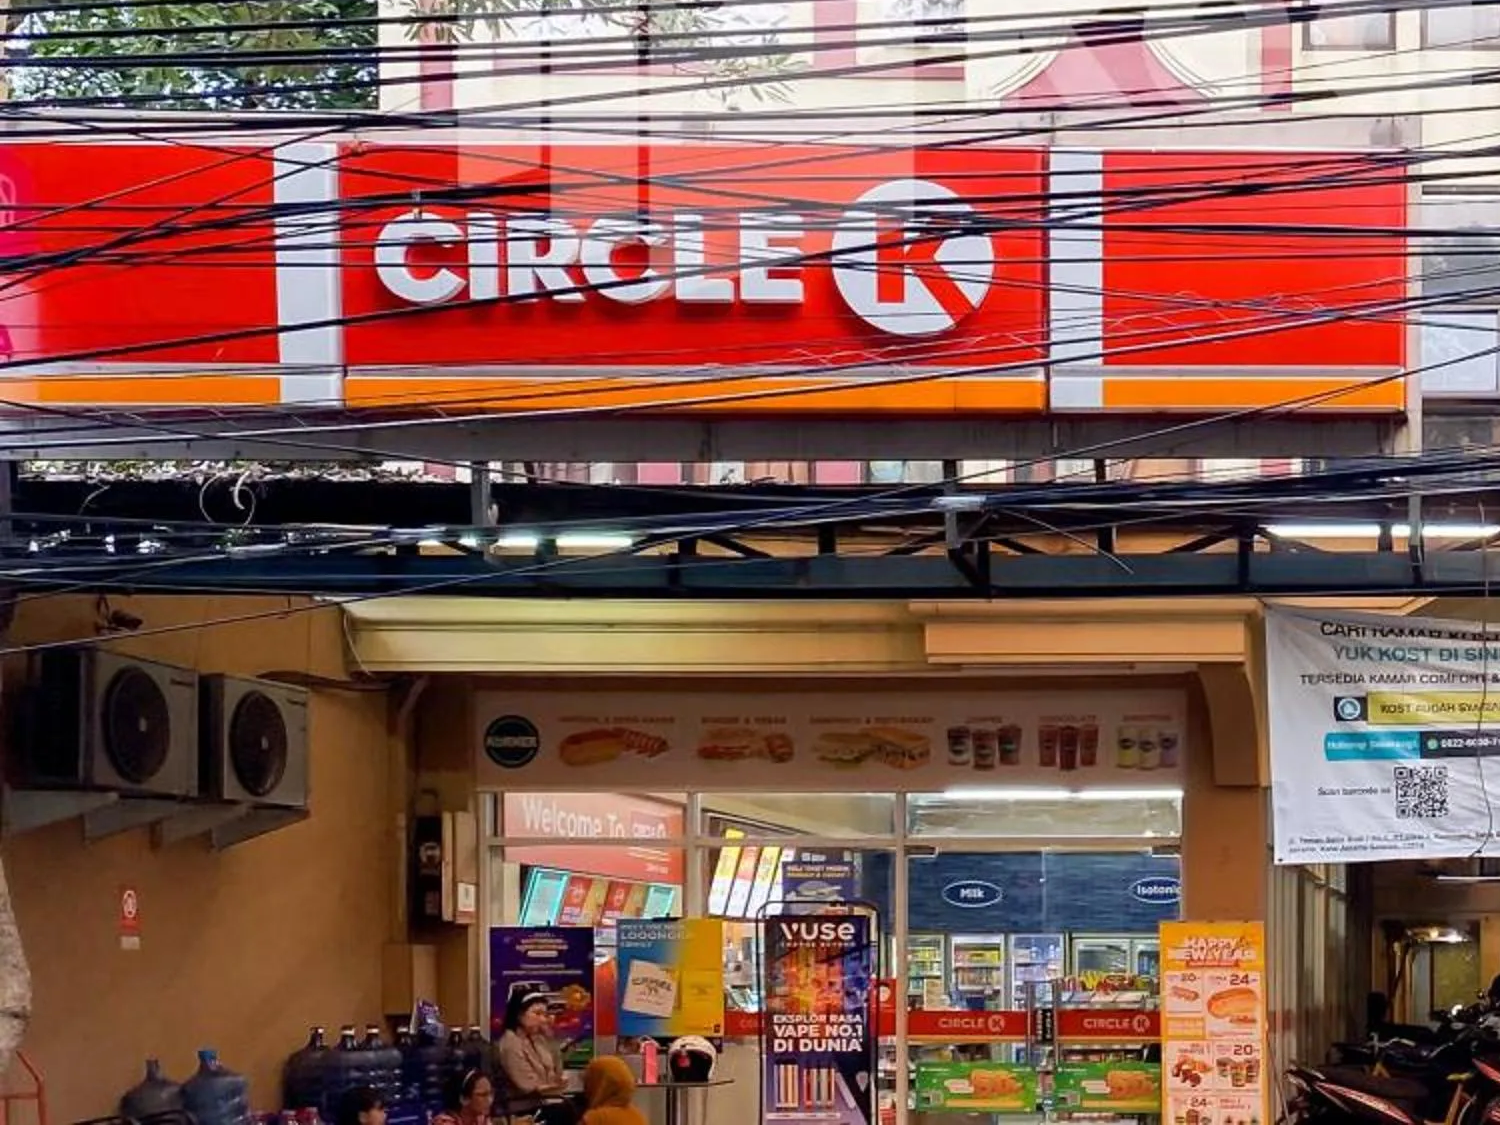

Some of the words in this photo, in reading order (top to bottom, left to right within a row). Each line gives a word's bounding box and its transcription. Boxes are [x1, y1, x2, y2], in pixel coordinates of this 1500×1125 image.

[375, 208, 804, 307] CIRCLE
[846, 186, 993, 332] K
[1320, 621, 1366, 638] CARI
[1333, 646, 1374, 662] YUK
[1378, 646, 1432, 663] KOST
[1439, 647, 1459, 662] DI
[1301, 674, 1365, 685] TERSEDIA
[1369, 674, 1417, 684] KAMAR
[1380, 703, 1412, 714] KOST
[522, 794, 602, 838] Welcome
[606, 811, 626, 838] To
[959, 887, 985, 899] Milk
[937, 1018, 985, 1029] CIRCLE
[1083, 1018, 1130, 1029] CIRCLE
[773, 1024, 821, 1038] VAPE
[824, 1024, 863, 1038] NO.1
[773, 1038, 794, 1052] DI
